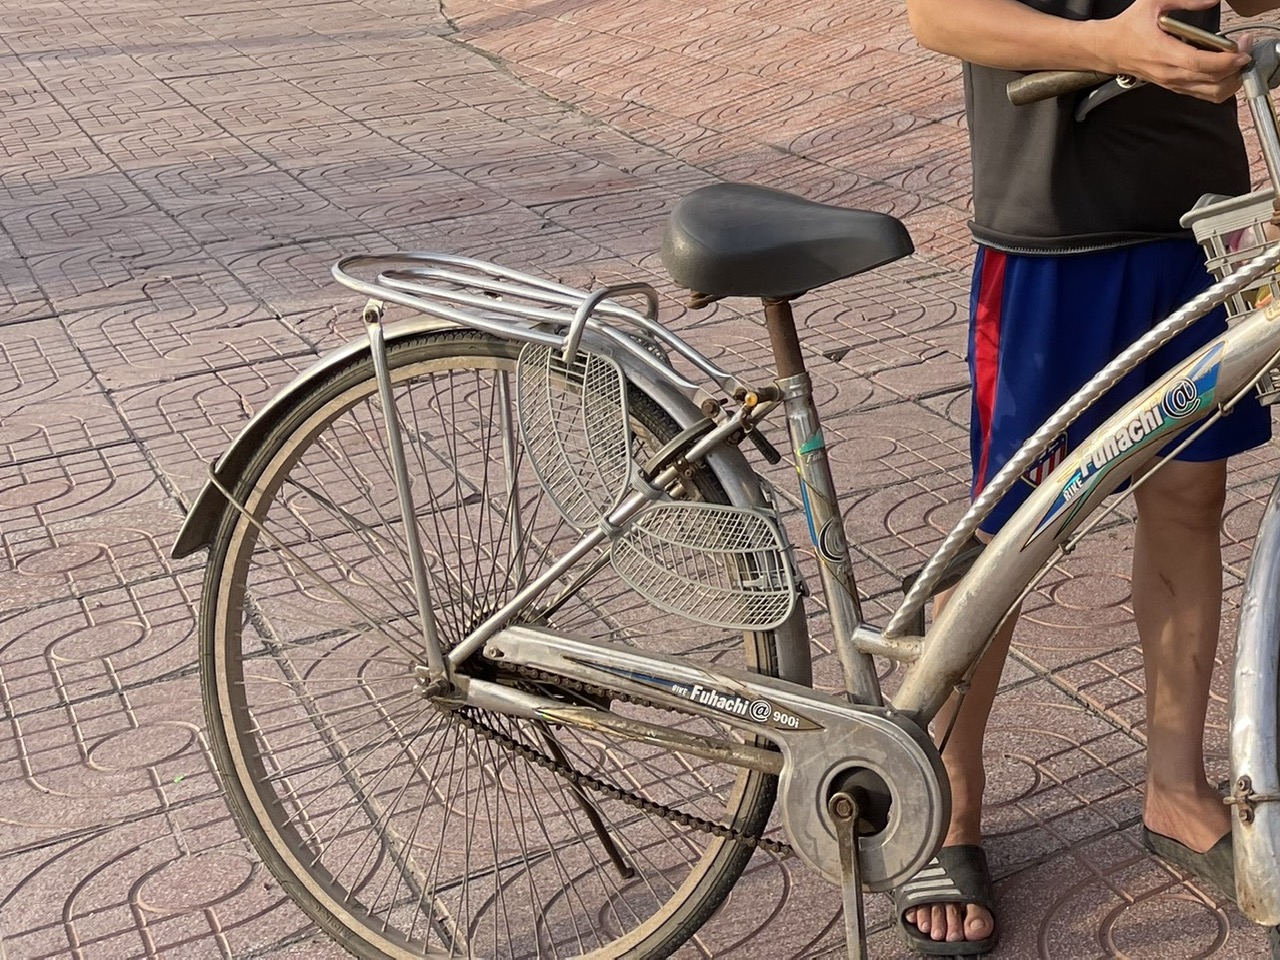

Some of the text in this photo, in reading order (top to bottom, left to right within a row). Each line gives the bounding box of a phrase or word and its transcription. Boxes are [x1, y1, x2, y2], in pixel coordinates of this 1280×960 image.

[1062, 477, 1084, 501] BIKE
[690, 684, 749, 715] Fuhachi
[773, 711, 800, 729] 900i
